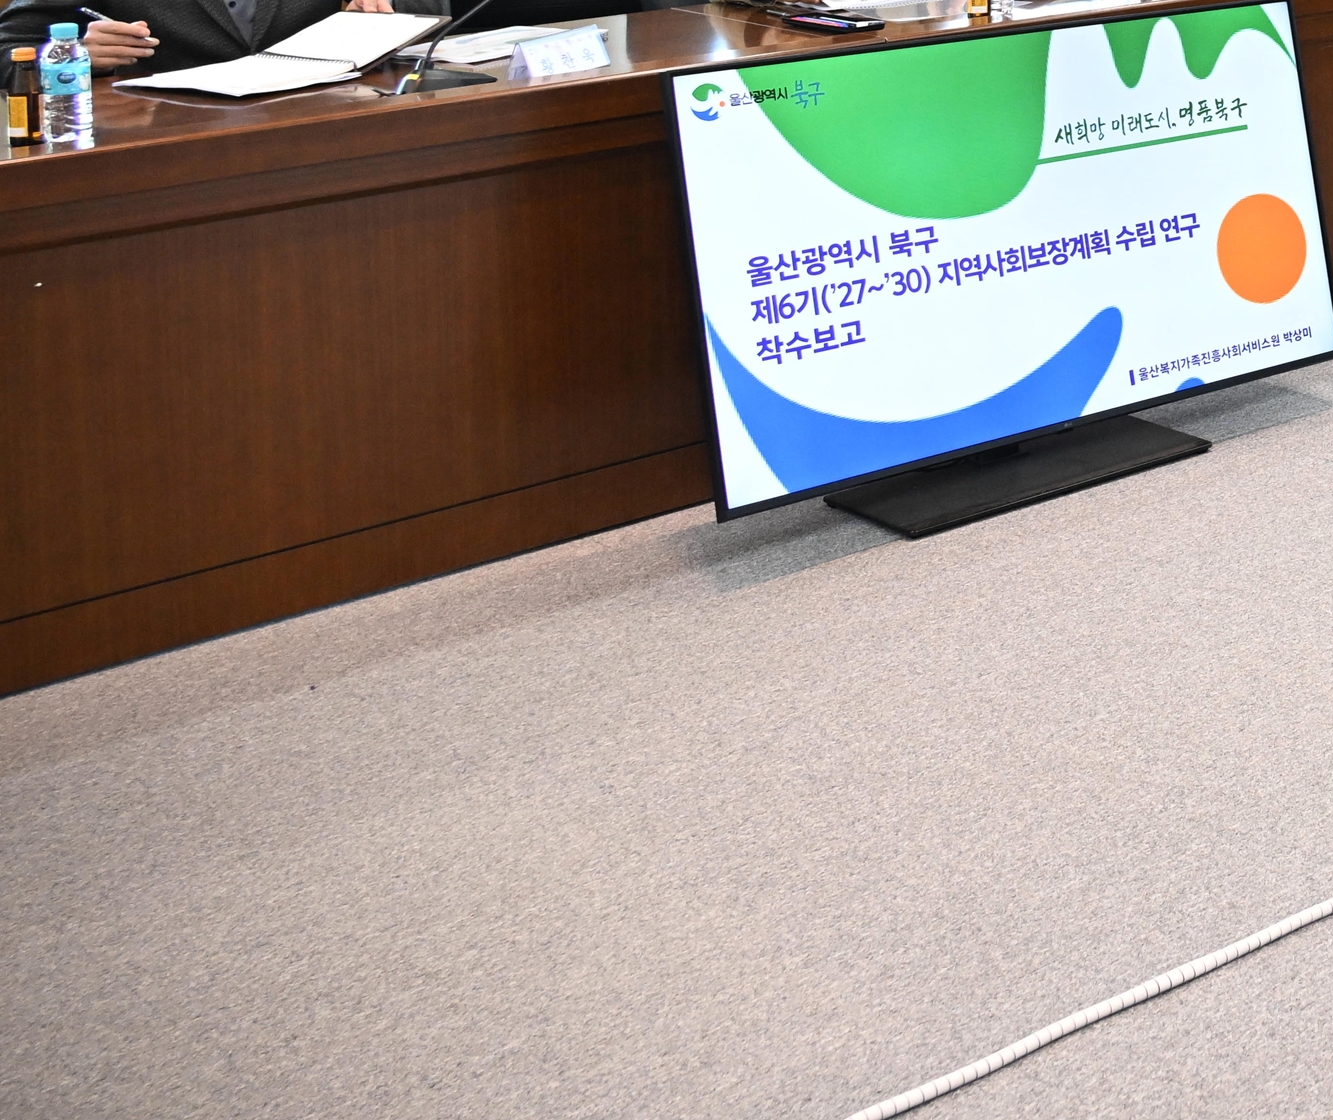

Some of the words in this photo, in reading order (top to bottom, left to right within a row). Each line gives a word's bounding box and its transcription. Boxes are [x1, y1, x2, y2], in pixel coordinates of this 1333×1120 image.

[728, 86, 789, 107] 울산광역시
[790, 79, 826, 109] 북구
[1054, 116, 1107, 146] 새희망
[1178, 97, 1248, 127] 명품북구
[746, 234, 881, 288] 울산광역시
[888, 225, 939, 258] 북구
[937, 228, 1112, 287] 지역사회보장계획
[1115, 220, 1157, 252] 수립
[1159, 212, 1201, 244] 연구
[756, 319, 867, 366] 착수보고
[1137, 333, 1281, 382] 울산복지가족진흥사회서비스원
[1282, 325, 1313, 344] 박상미
